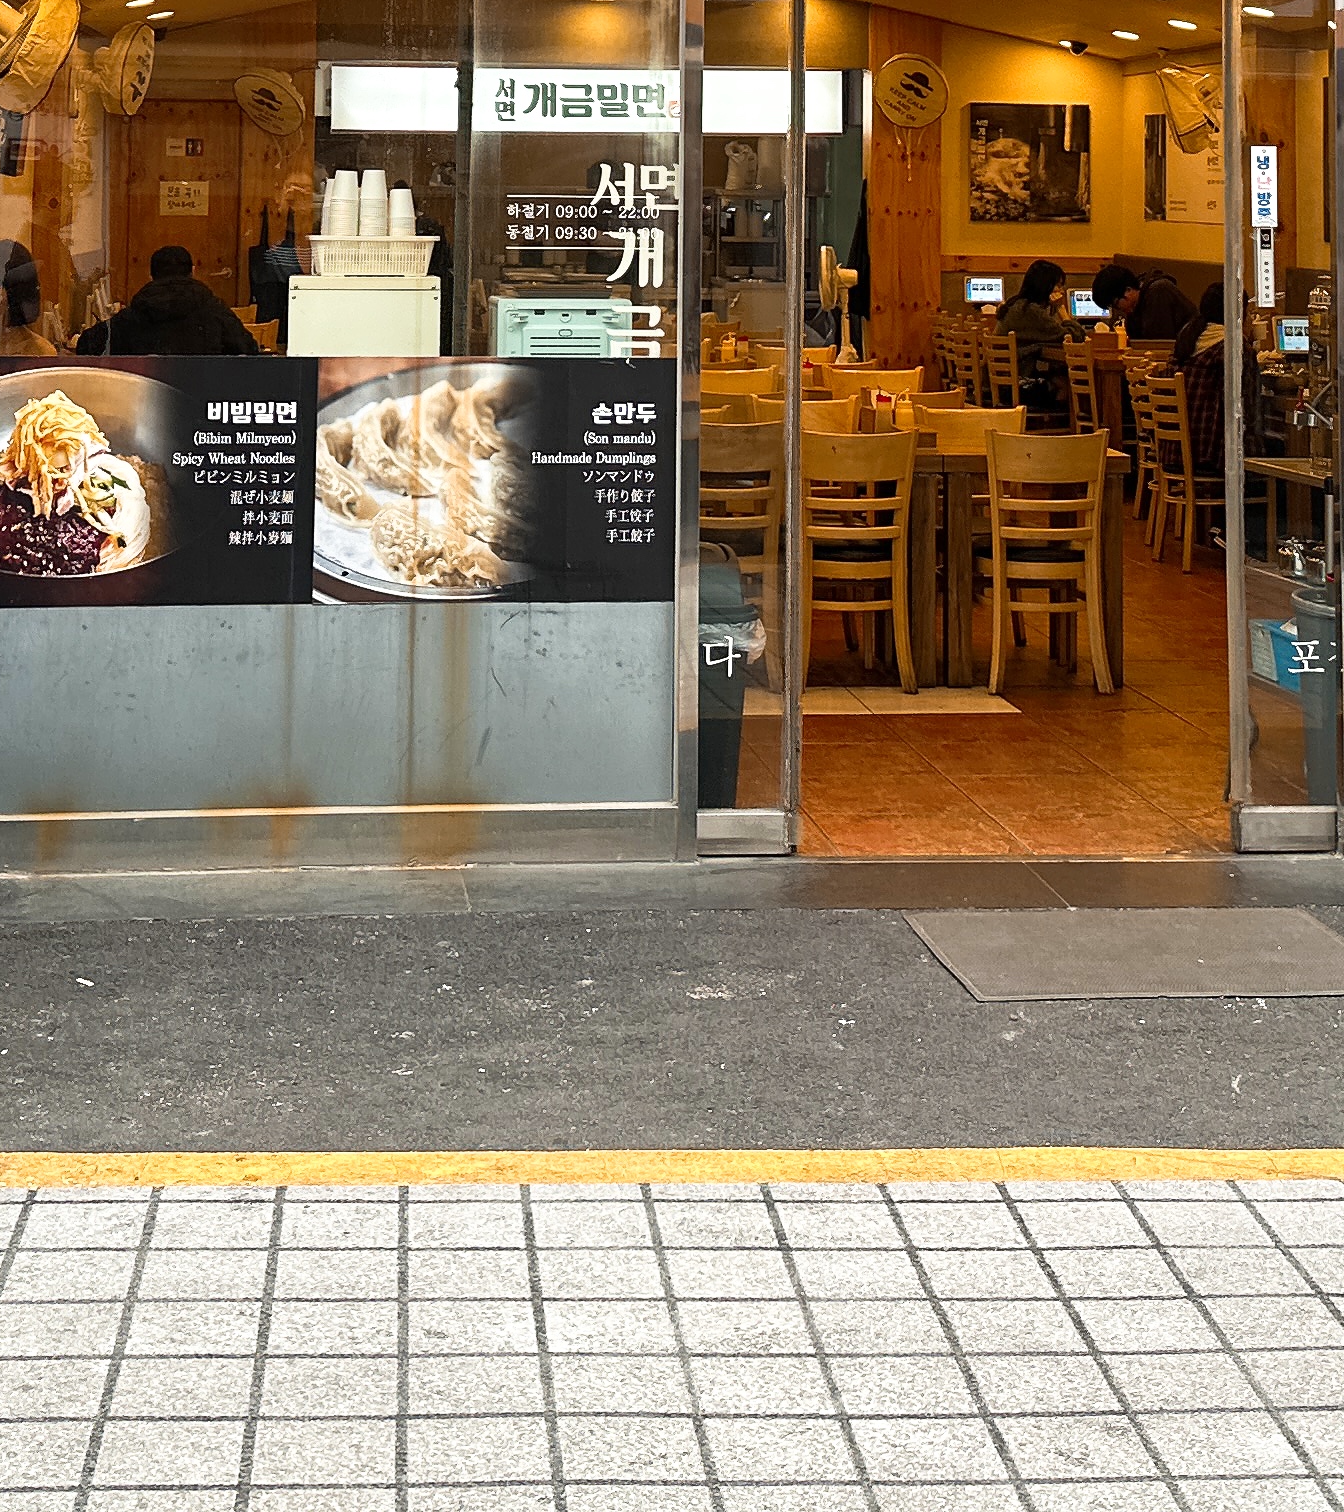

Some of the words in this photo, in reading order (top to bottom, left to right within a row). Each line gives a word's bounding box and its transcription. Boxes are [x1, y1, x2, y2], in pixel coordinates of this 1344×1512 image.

[495, 78, 517, 122] 서면
[522, 82, 667, 119] 개금밀면
[590, 162, 679, 210] 서면
[506, 203, 550, 219] 하절기
[555, 204, 598, 219] 09:00
[618, 204, 660, 219] 22:00
[506, 224, 550, 240] 동절기
[555, 225, 598, 240] 09:30
[207, 401, 297, 424] 비빔밀면
[591, 402, 656, 425] 손만두
[193, 430, 232, 446] (Bibim
[235, 430, 297, 446] Milmyeon)
[583, 430, 609, 446] (Son
[612, 430, 656, 446] mandu)
[172, 452, 204, 467] Spicy
[208, 452, 247, 465] Wheat
[250, 452, 296, 465] Noodles
[531, 451, 593, 465] Handmade
[596, 451, 656, 466] Dumplings
[582, 469, 655, 483] ソンマンドゥ
[702, 635, 742, 678] 다
